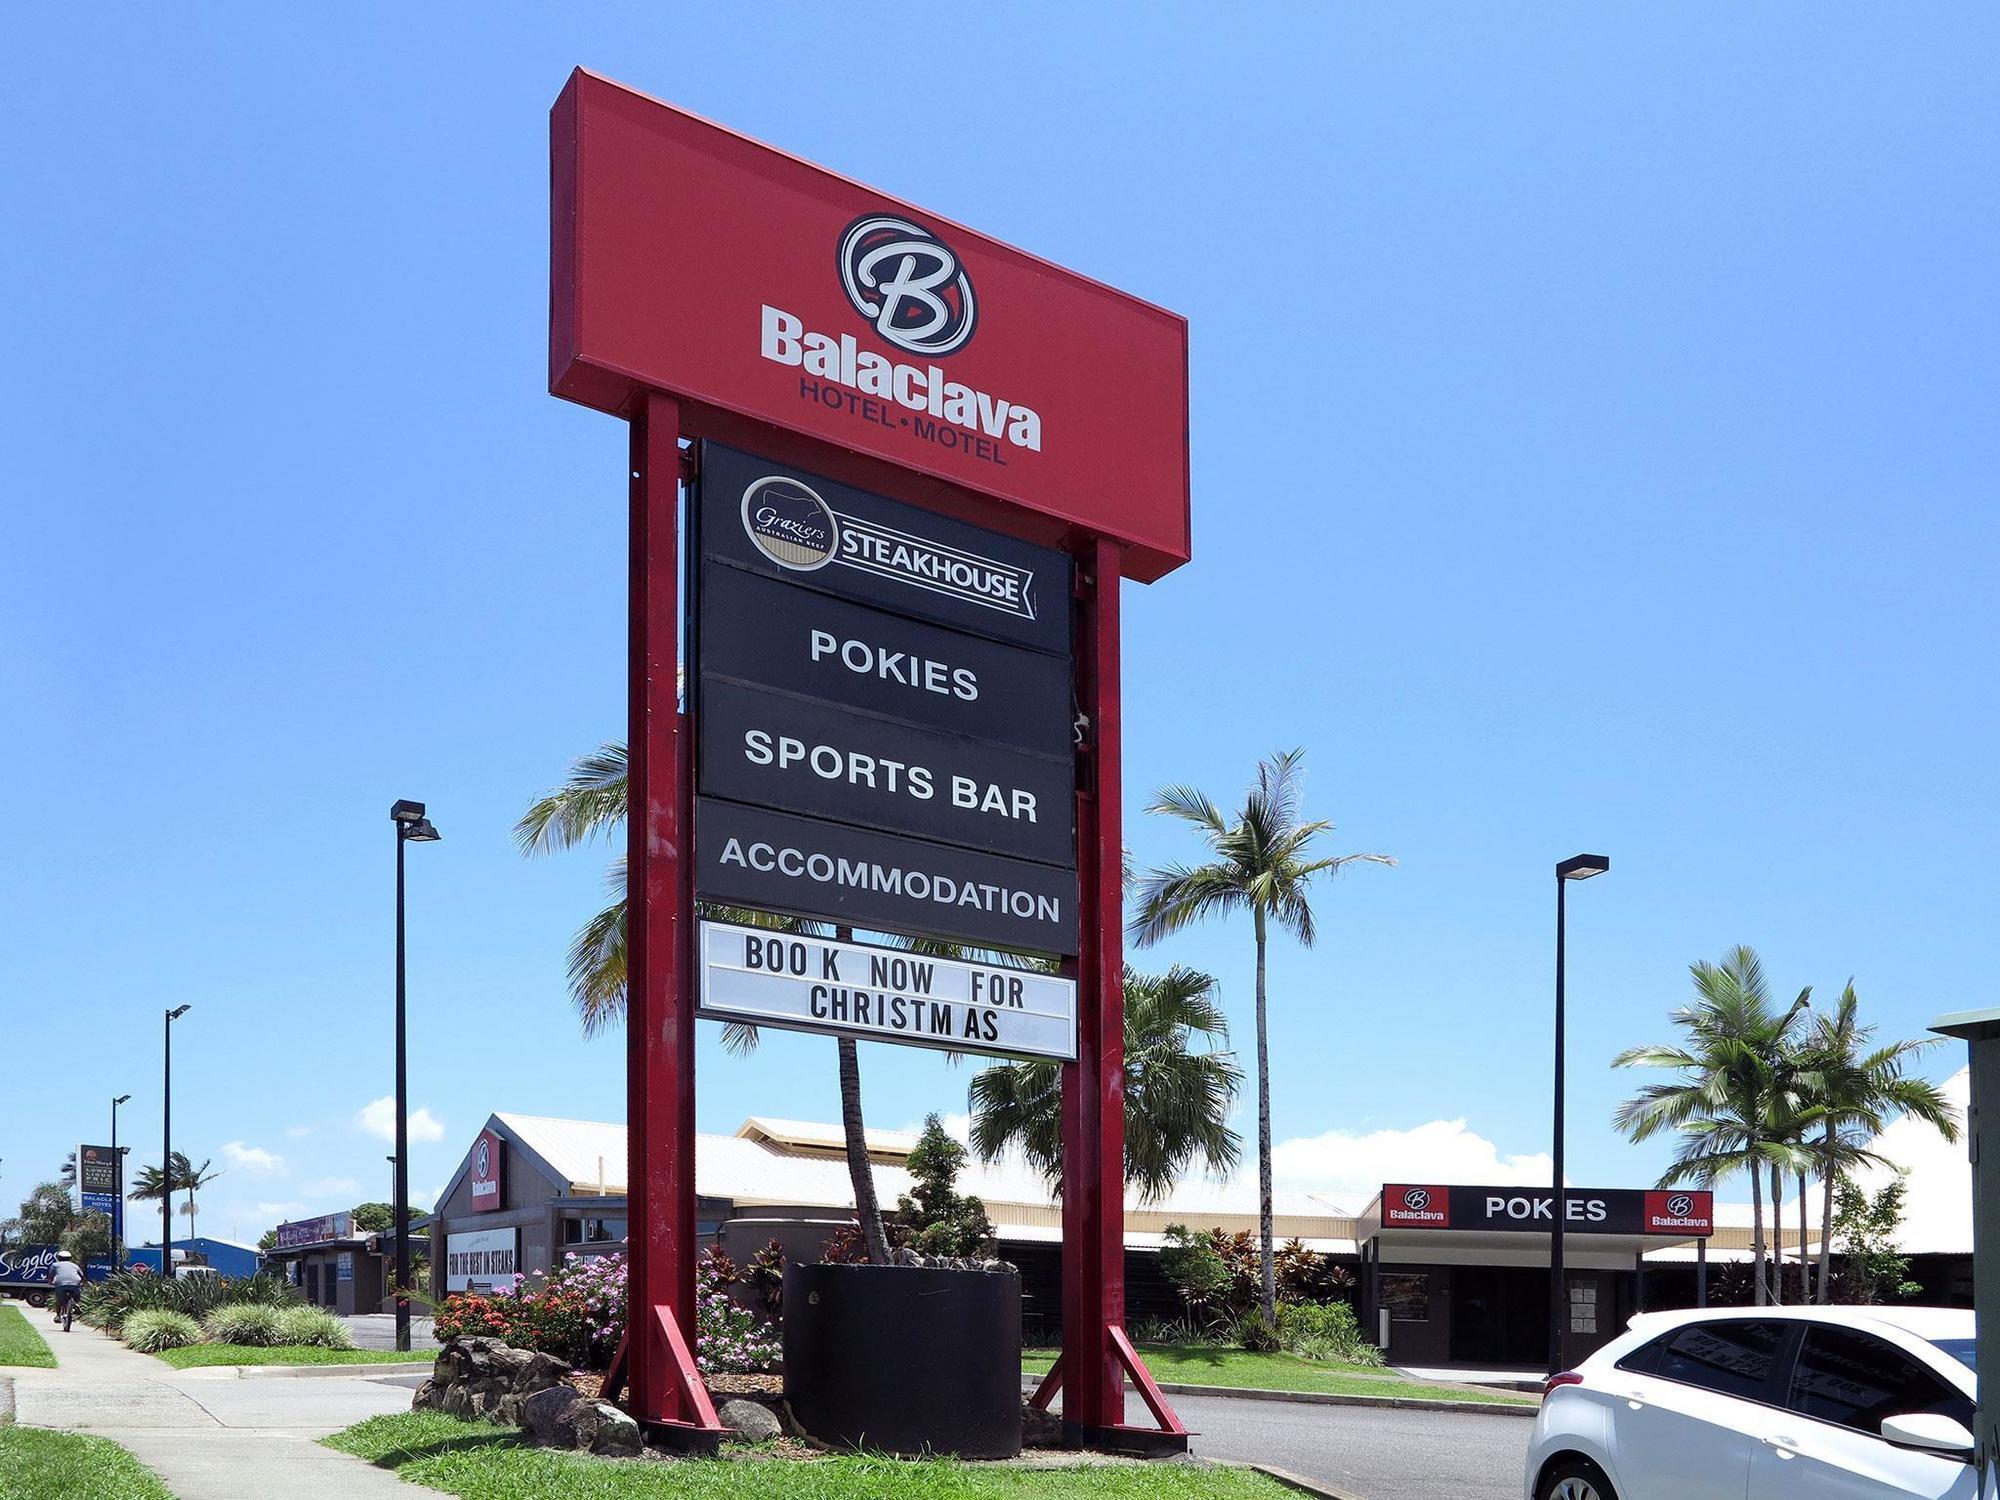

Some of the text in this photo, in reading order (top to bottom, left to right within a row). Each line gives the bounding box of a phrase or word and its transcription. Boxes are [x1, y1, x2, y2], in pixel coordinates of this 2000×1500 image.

[760, 303, 1042, 453] Balaclava
[799, 377, 1008, 466] HOTEL MOTEL
[756, 507, 825, 539] Graziers
[756, 526, 825, 550] AUSTRALIAN BEEF
[842, 529, 1020, 603] STEAKHOUSE
[810, 628, 979, 702] POKIES
[744, 729, 1038, 823] SPORTS BAR
[718, 837, 1061, 924] ACCOMMODATION
[871, 954, 934, 995] NOW
[971, 971, 1024, 1009] FOR
[83, 1195, 120, 1203] BALACLAA
[1389, 1209, 1444, 1220] Balaclava
[1485, 1196, 1607, 1221] POKES
[1651, 1216, 1708, 1227] Balaclava
[459, 1252, 469, 1275] THE
[469, 1251, 483, 1275] BEST
[490, 1249, 514, 1275] STEAKS
